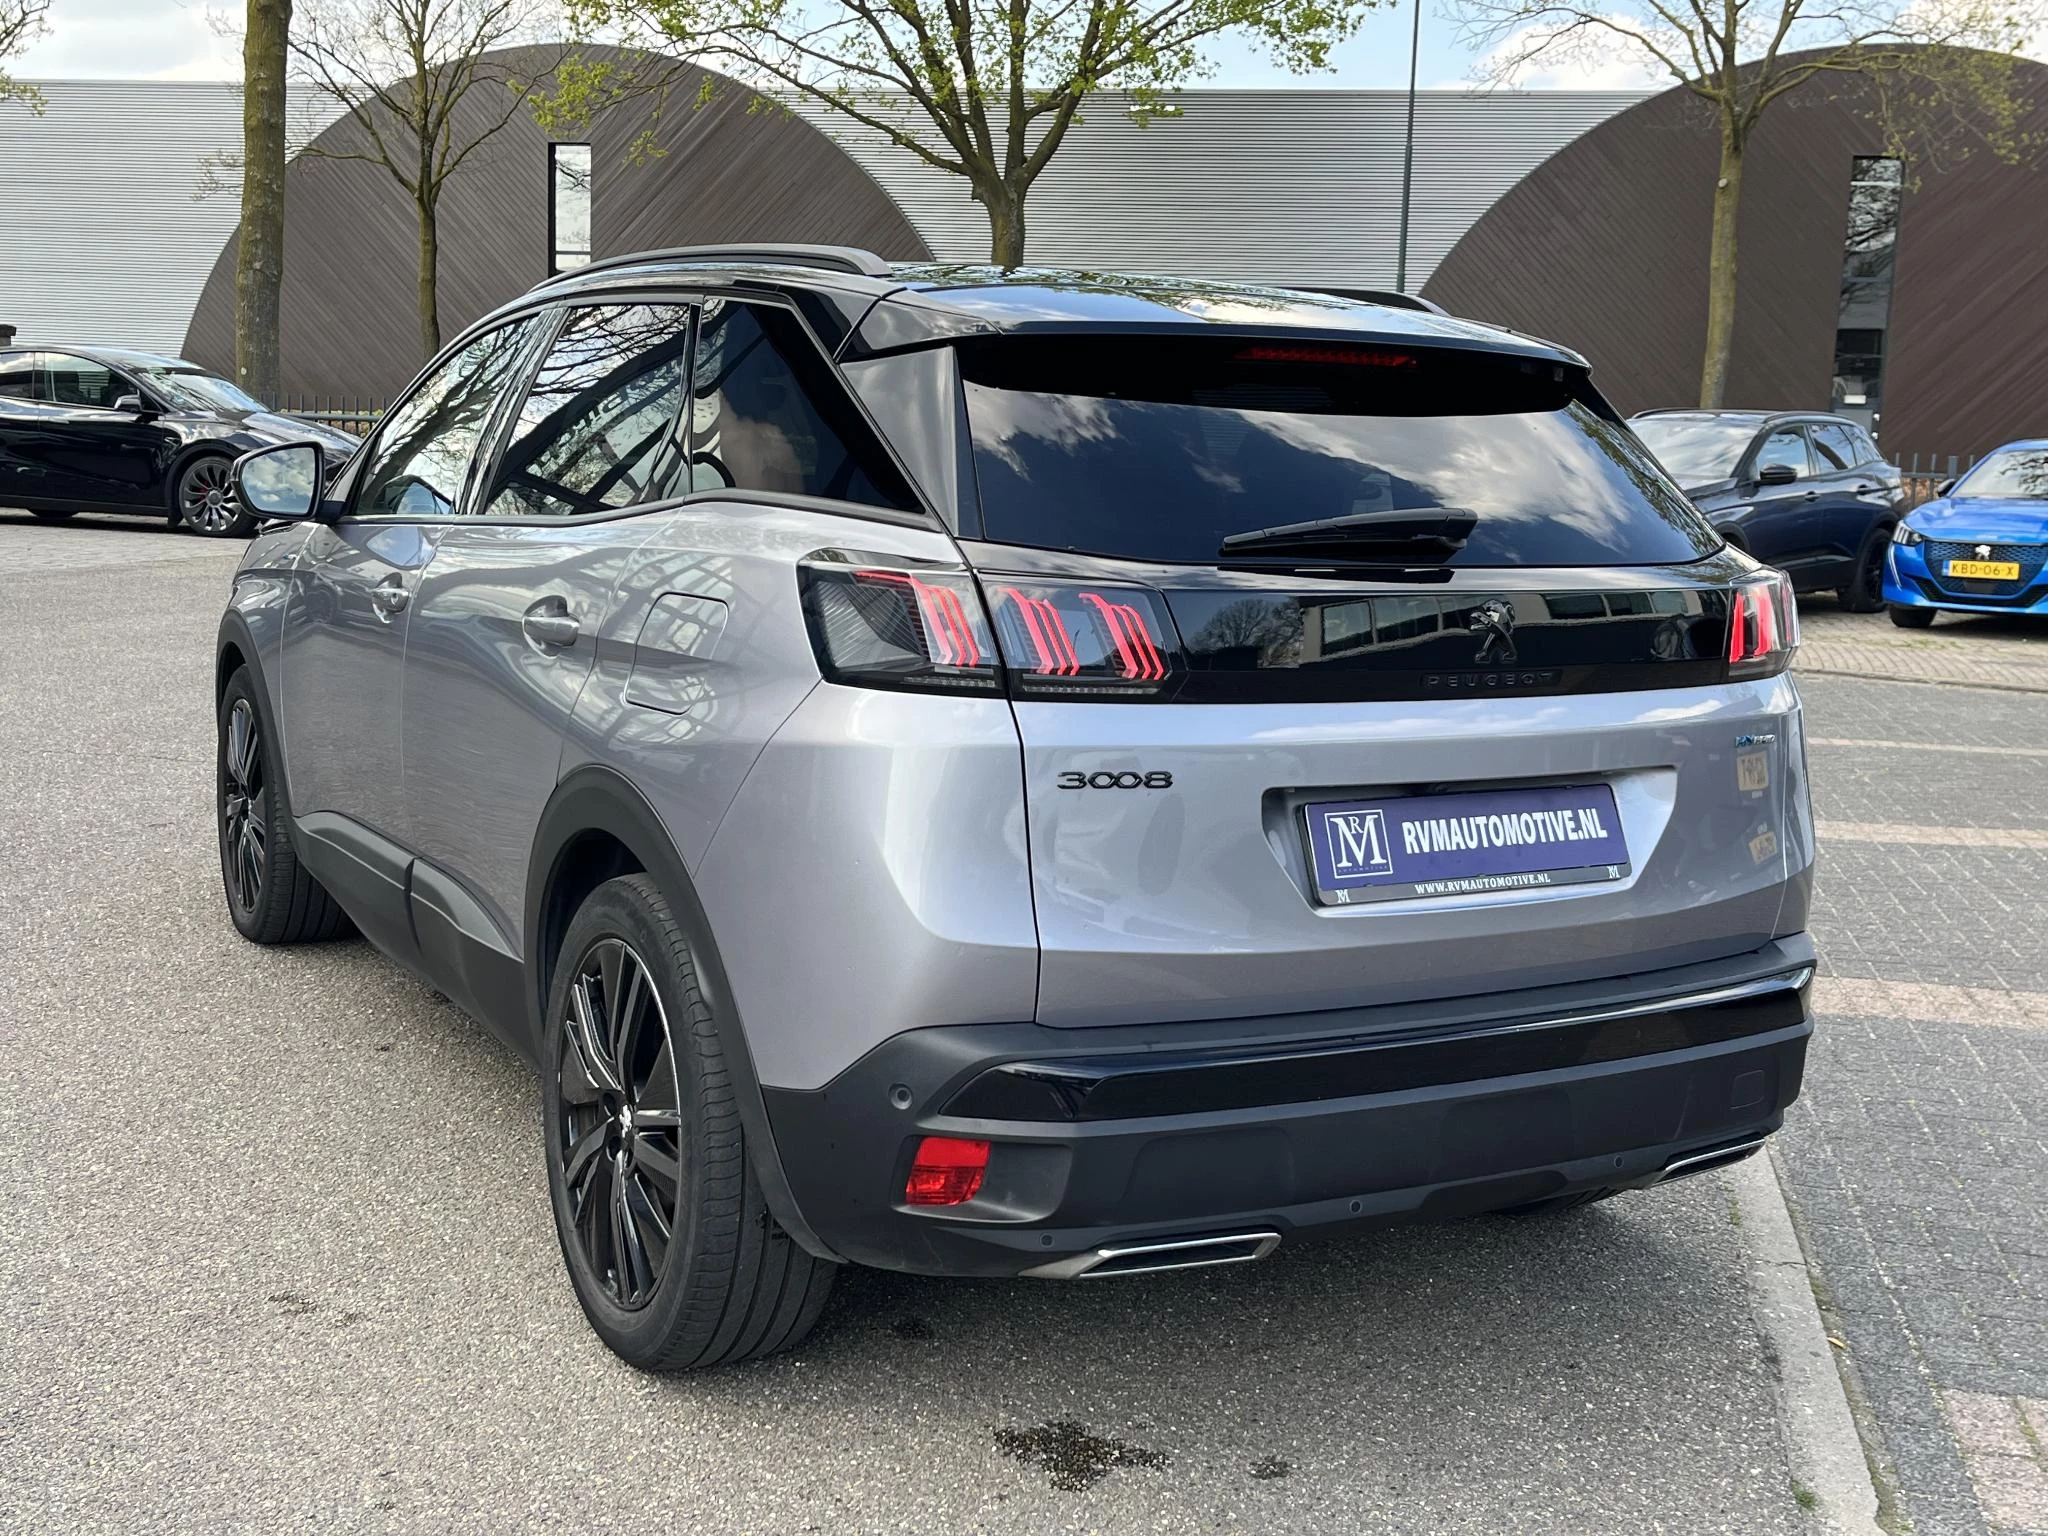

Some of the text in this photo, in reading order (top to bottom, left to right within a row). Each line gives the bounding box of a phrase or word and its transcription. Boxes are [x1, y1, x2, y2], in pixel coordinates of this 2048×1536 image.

[1952, 562, 2014, 577] KBD-06-X
[1427, 672, 1553, 688] PEUGEOT
[1057, 770, 1174, 790] 3008
[1401, 808, 1608, 855] RVMAUTOMOTIVE.NL
[1414, 874, 1551, 894] WWW.RVMAUTOMOTIVE.NL
